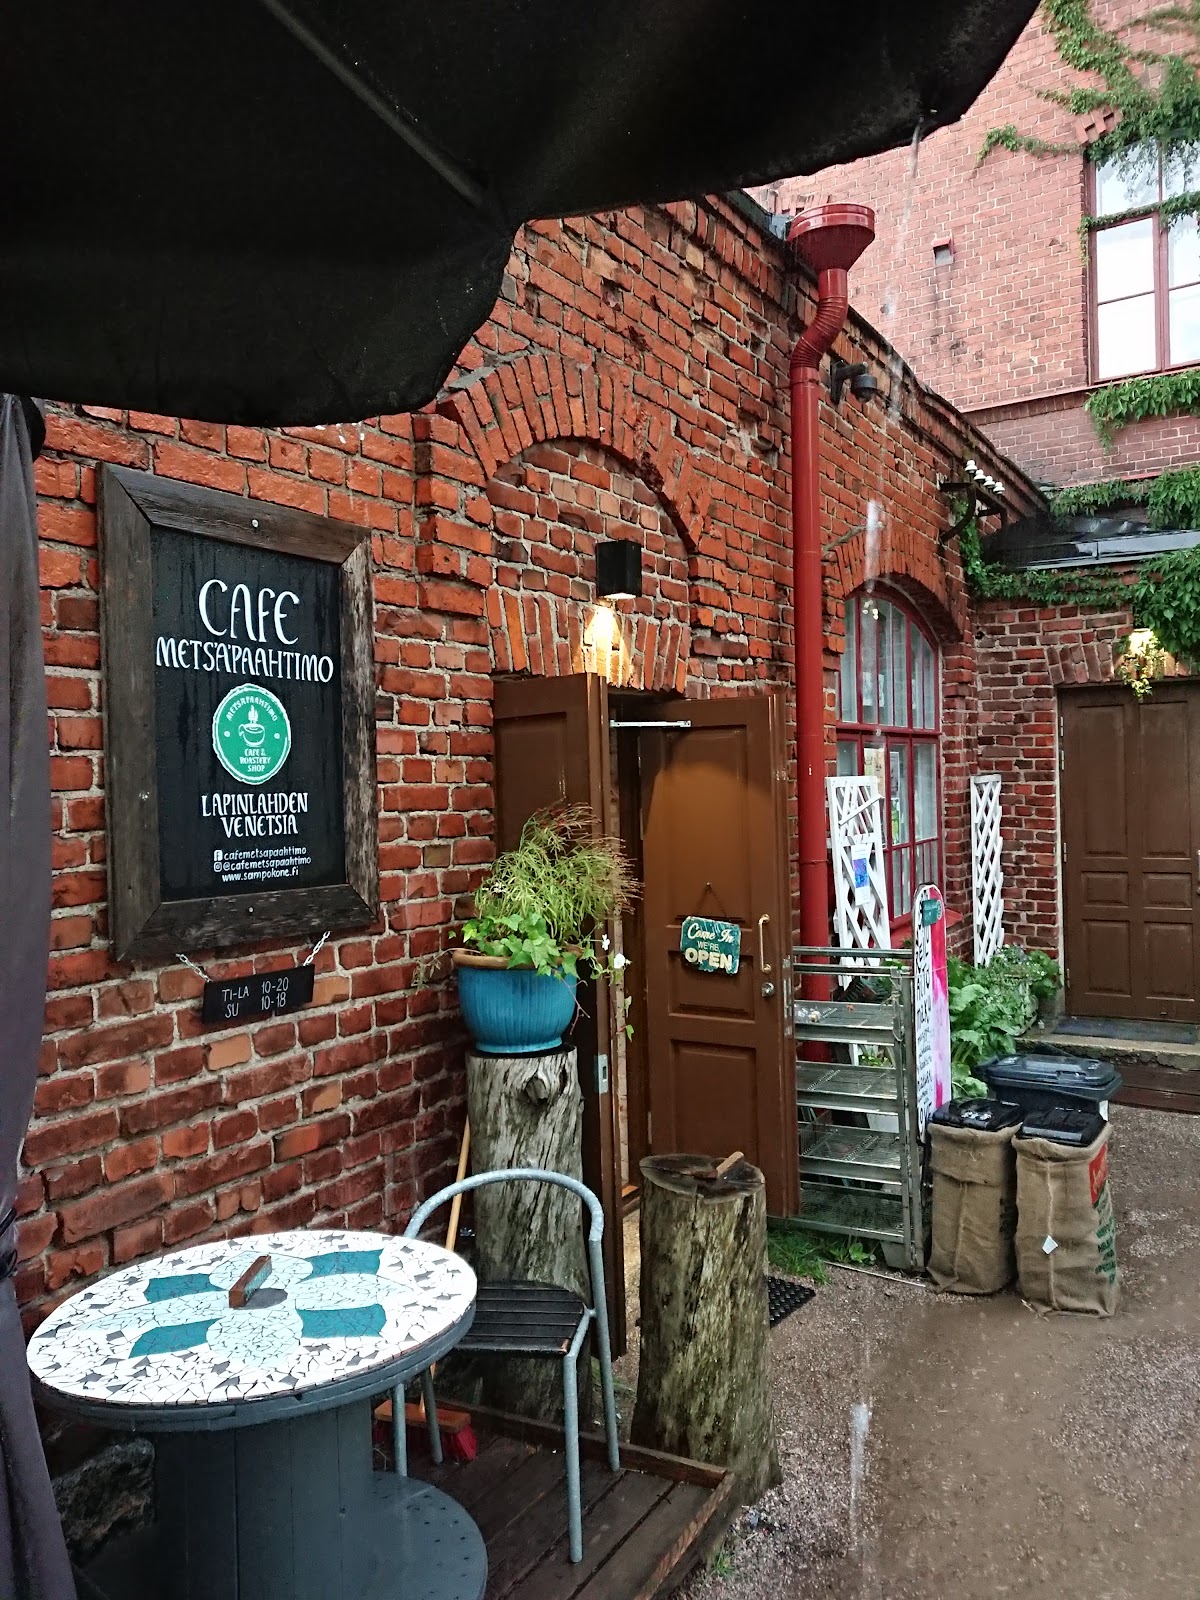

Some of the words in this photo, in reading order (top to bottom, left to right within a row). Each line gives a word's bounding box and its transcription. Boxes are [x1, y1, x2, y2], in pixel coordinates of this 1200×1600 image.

[198, 579, 300, 645] CAFE
[239, 756, 271, 765] ROASTERY
[244, 748, 260, 757] CAFE
[247, 764, 265, 772] SHOP
[201, 791, 309, 817] LAPINLAHDEN
[220, 814, 299, 839] VENETSIA
[224, 845, 307, 861] cafemetsapaahtimo
[221, 866, 299, 882] www.sampokone.fi
[687, 922, 716, 940] Come
[717, 928, 735, 944] In
[684, 947, 733, 970] OPEN
[221, 985, 250, 1002] TI-LA
[261, 976, 289, 995] 10-20
[224, 1002, 239, 1019] SU
[260, 991, 287, 1011] 10-18
